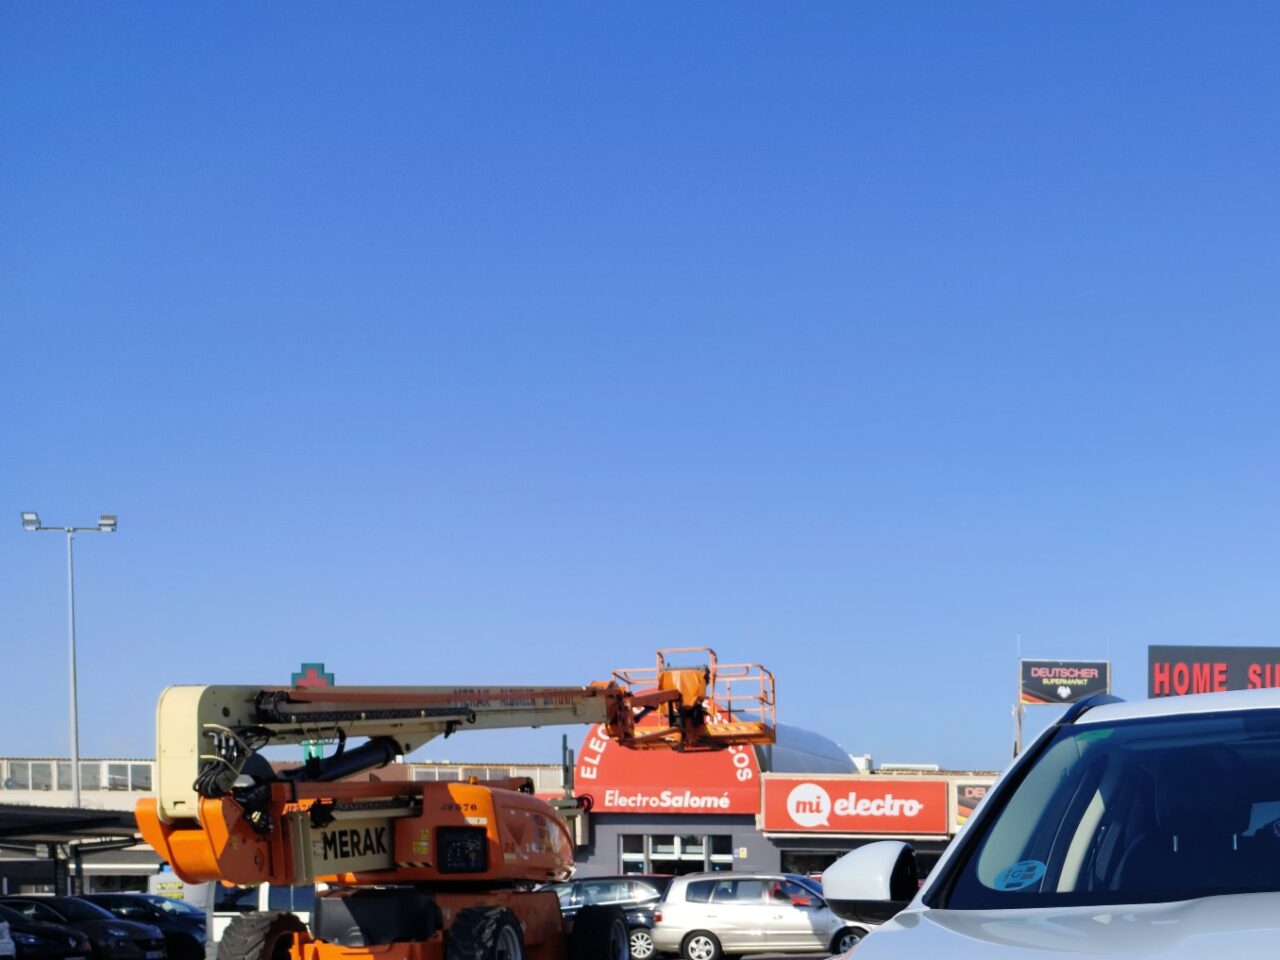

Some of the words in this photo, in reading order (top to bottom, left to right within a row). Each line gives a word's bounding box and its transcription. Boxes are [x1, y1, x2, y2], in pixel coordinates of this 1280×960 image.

[1031, 667, 1099, 678] DEUTSCHER
[1154, 662, 1228, 696] HOME
[795, 795, 824, 814] mi
[833, 791, 924, 817] electro
[322, 827, 388, 860] MERAK
